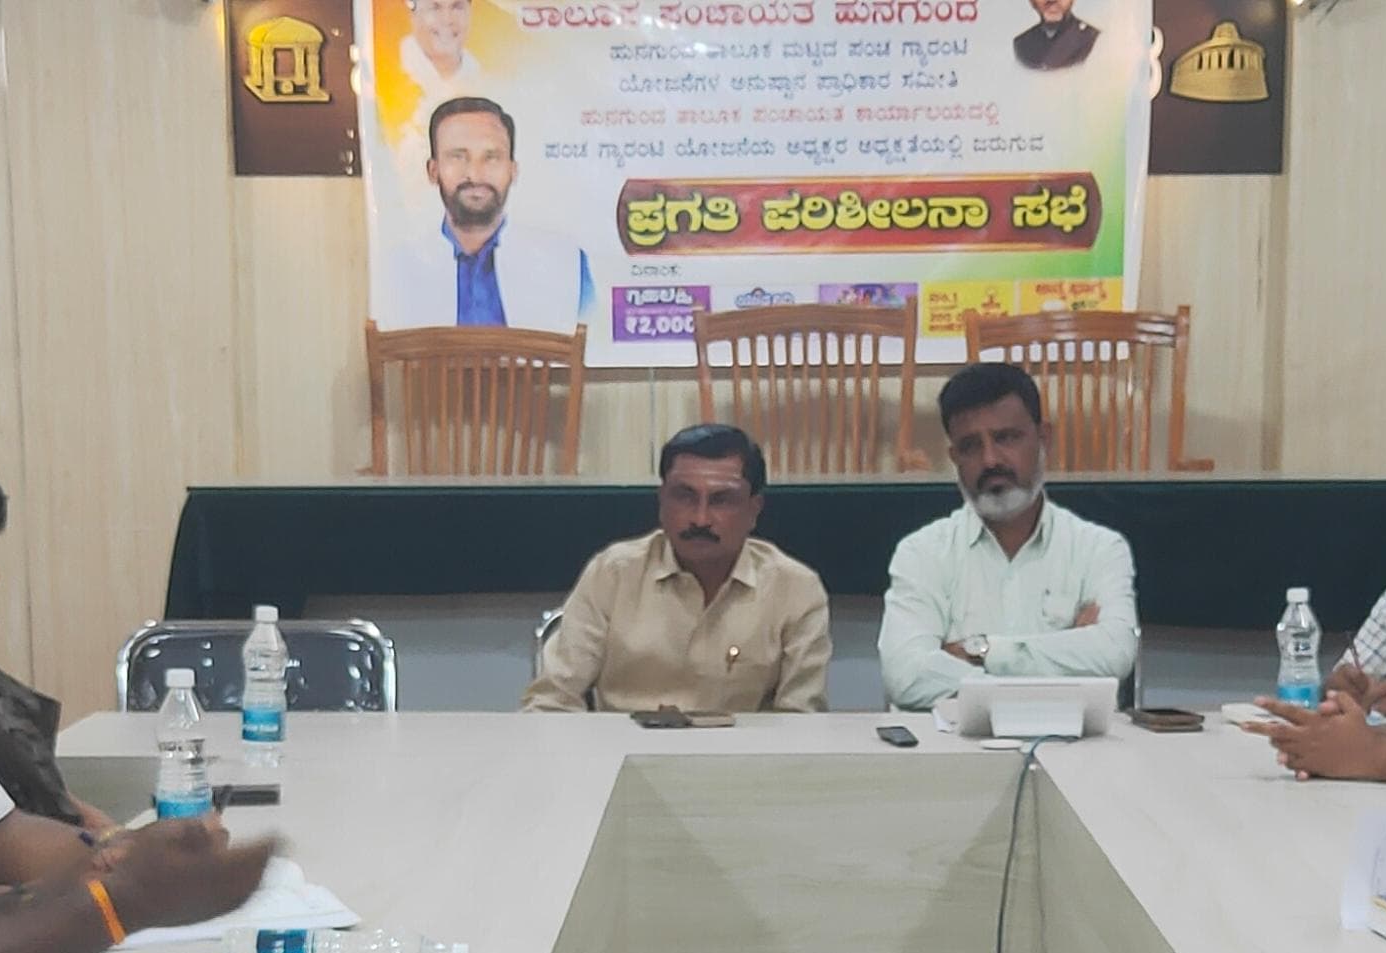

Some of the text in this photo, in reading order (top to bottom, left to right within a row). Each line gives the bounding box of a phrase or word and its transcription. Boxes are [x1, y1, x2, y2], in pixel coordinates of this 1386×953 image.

[834, 0, 979, 25] ಹುನಗುಂದ
[848, 39, 891, 58] ಪಂಚ
[544, 141, 589, 159] ಪಂಚ
[627, 184, 1089, 247] ಪ್ರಗತಿ ಪರಿಶೀಲನಾ ಸಭೆ
